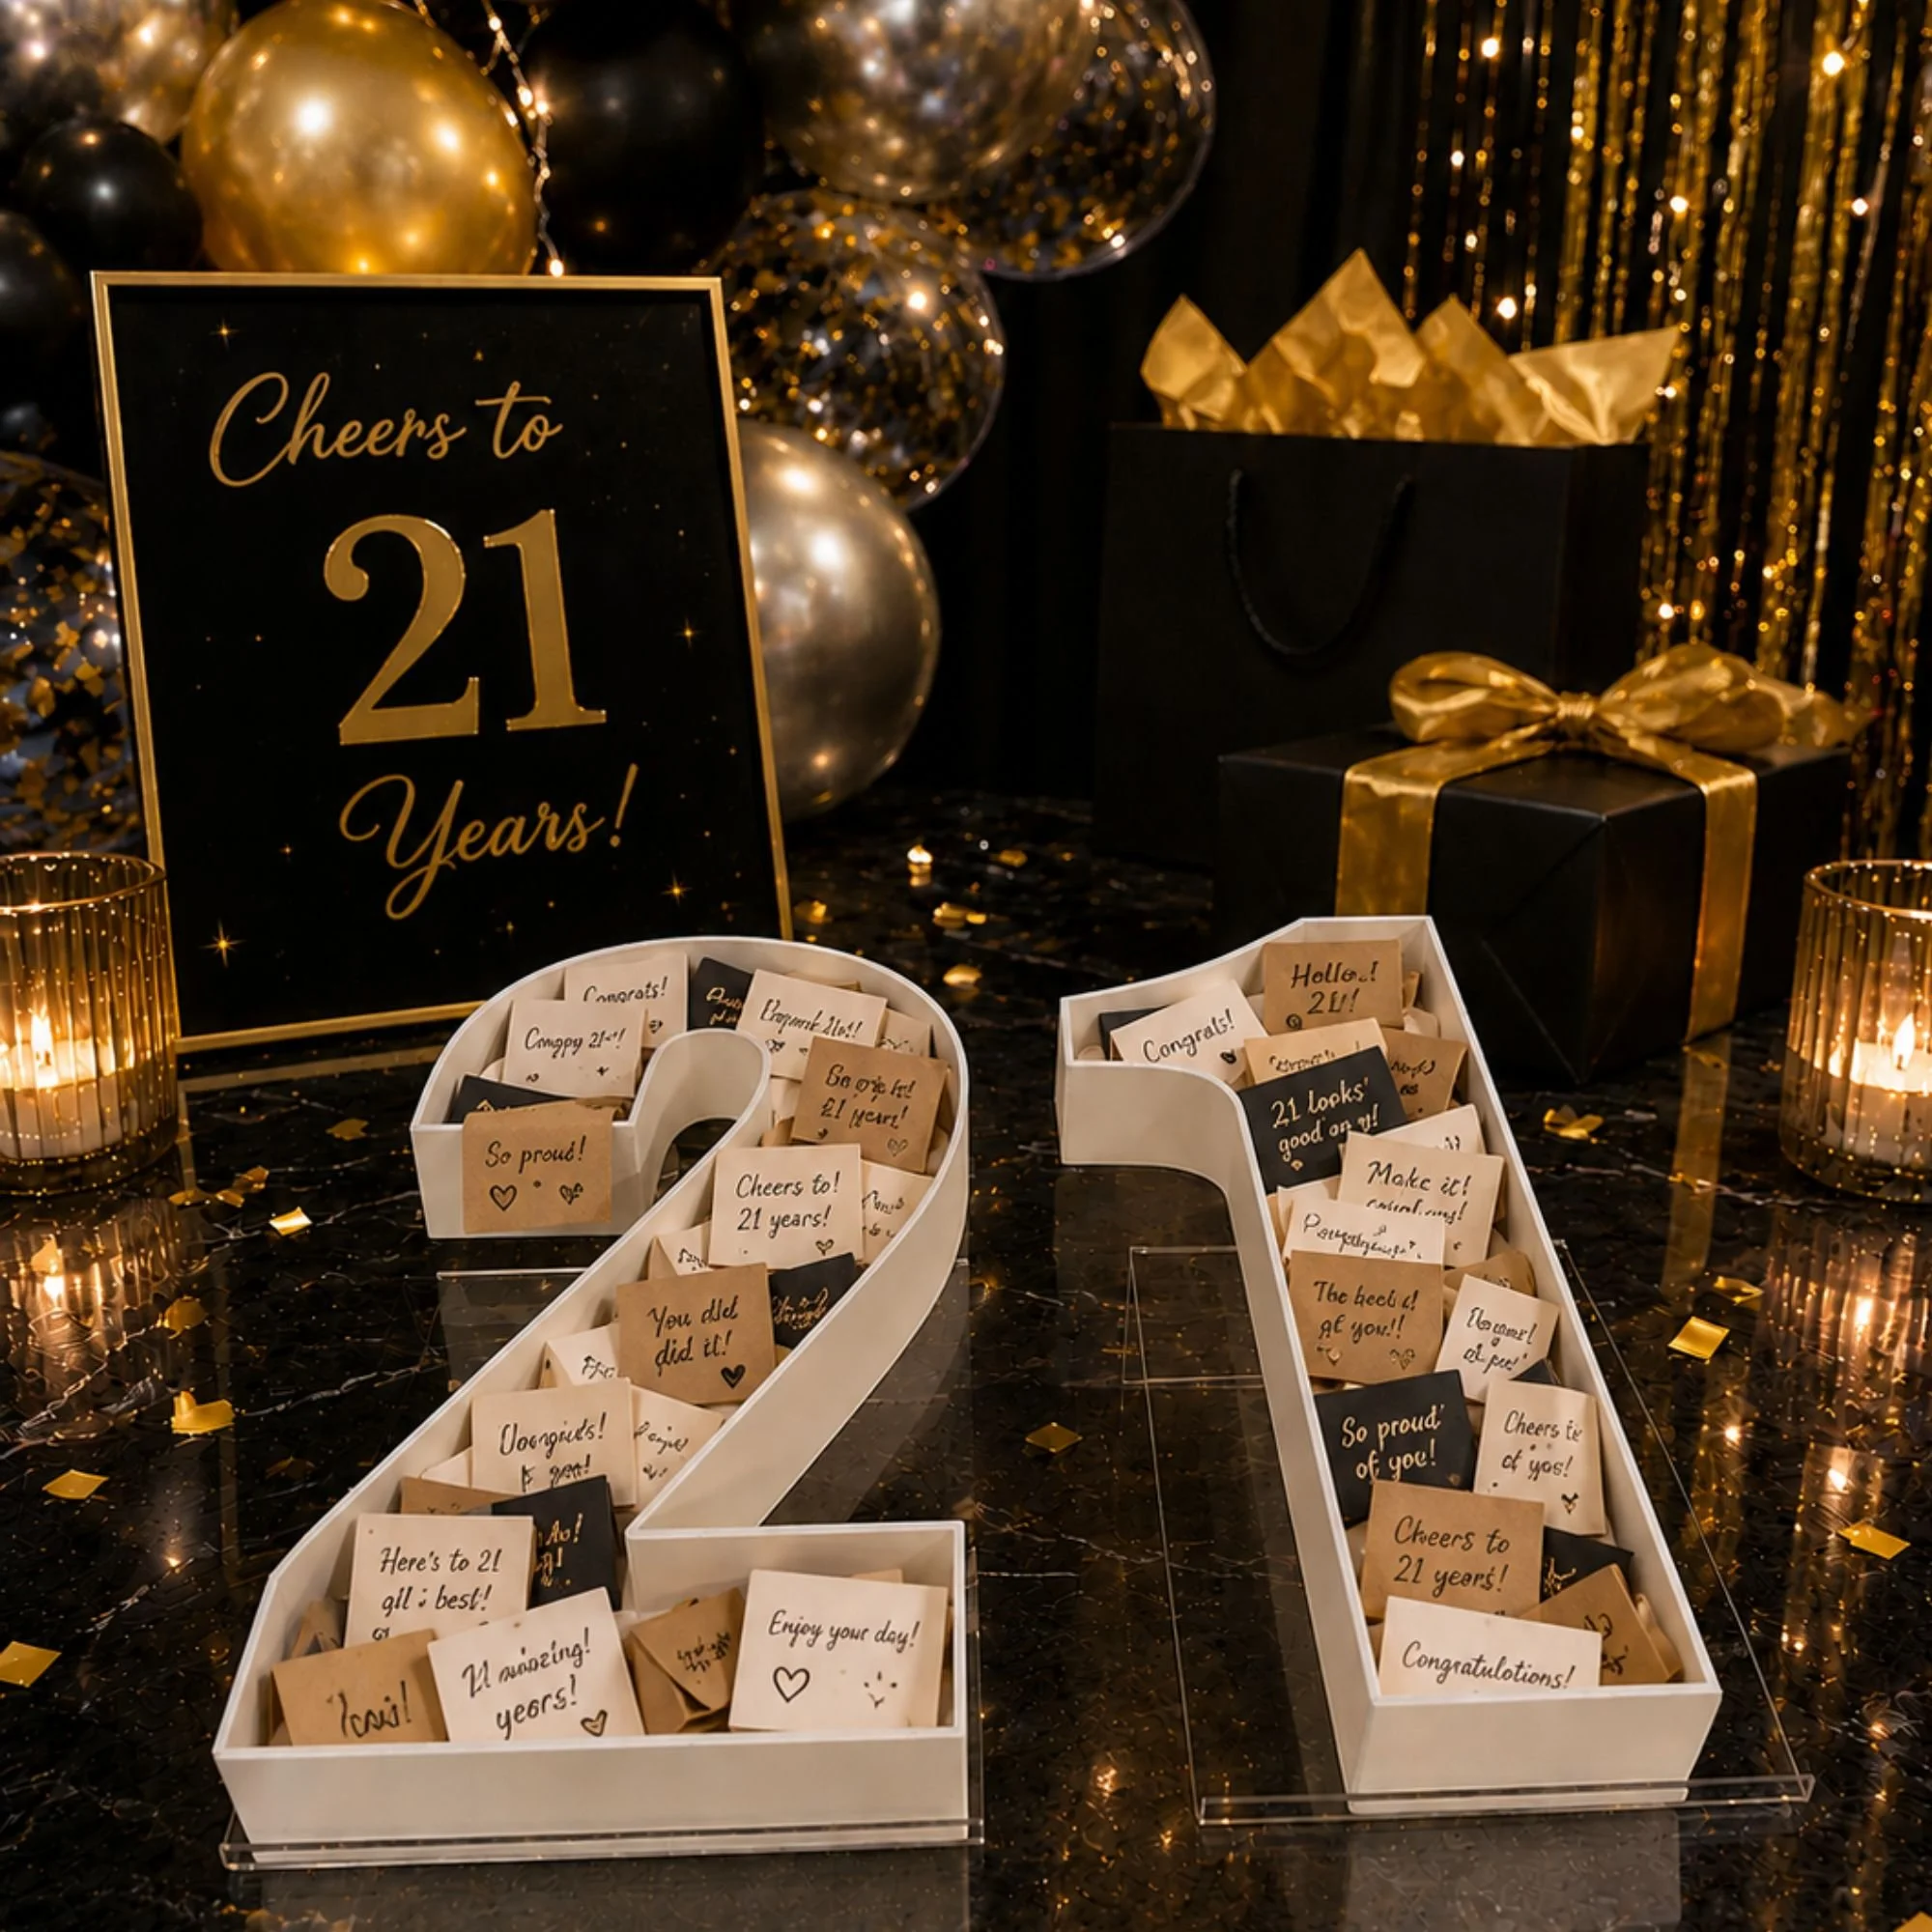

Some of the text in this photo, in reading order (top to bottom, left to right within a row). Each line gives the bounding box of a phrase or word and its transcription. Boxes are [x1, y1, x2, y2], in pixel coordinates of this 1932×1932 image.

[208, 371, 563, 487] Cheers to
[323, 508, 607, 746] 21
[339, 763, 639, 920] Years!
[1270, 1096, 1302, 1129] 21
[485, 1140, 512, 1168] So
[736, 1171, 840, 1199] Cheers to!
[737, 1208, 760, 1231] 21
[769, 1205, 832, 1238] years!
[647, 1305, 692, 1338] You
[1342, 1416, 1368, 1449] So
[1503, 1409, 1561, 1439] Cheers
[1394, 1515, 1511, 1554] Cheers to
[380, 1546, 440, 1575] Here's
[449, 1548, 470, 1573] to
[1393, 1553, 1425, 1585] 21
[767, 1608, 921, 1653] Enjoy your day!
